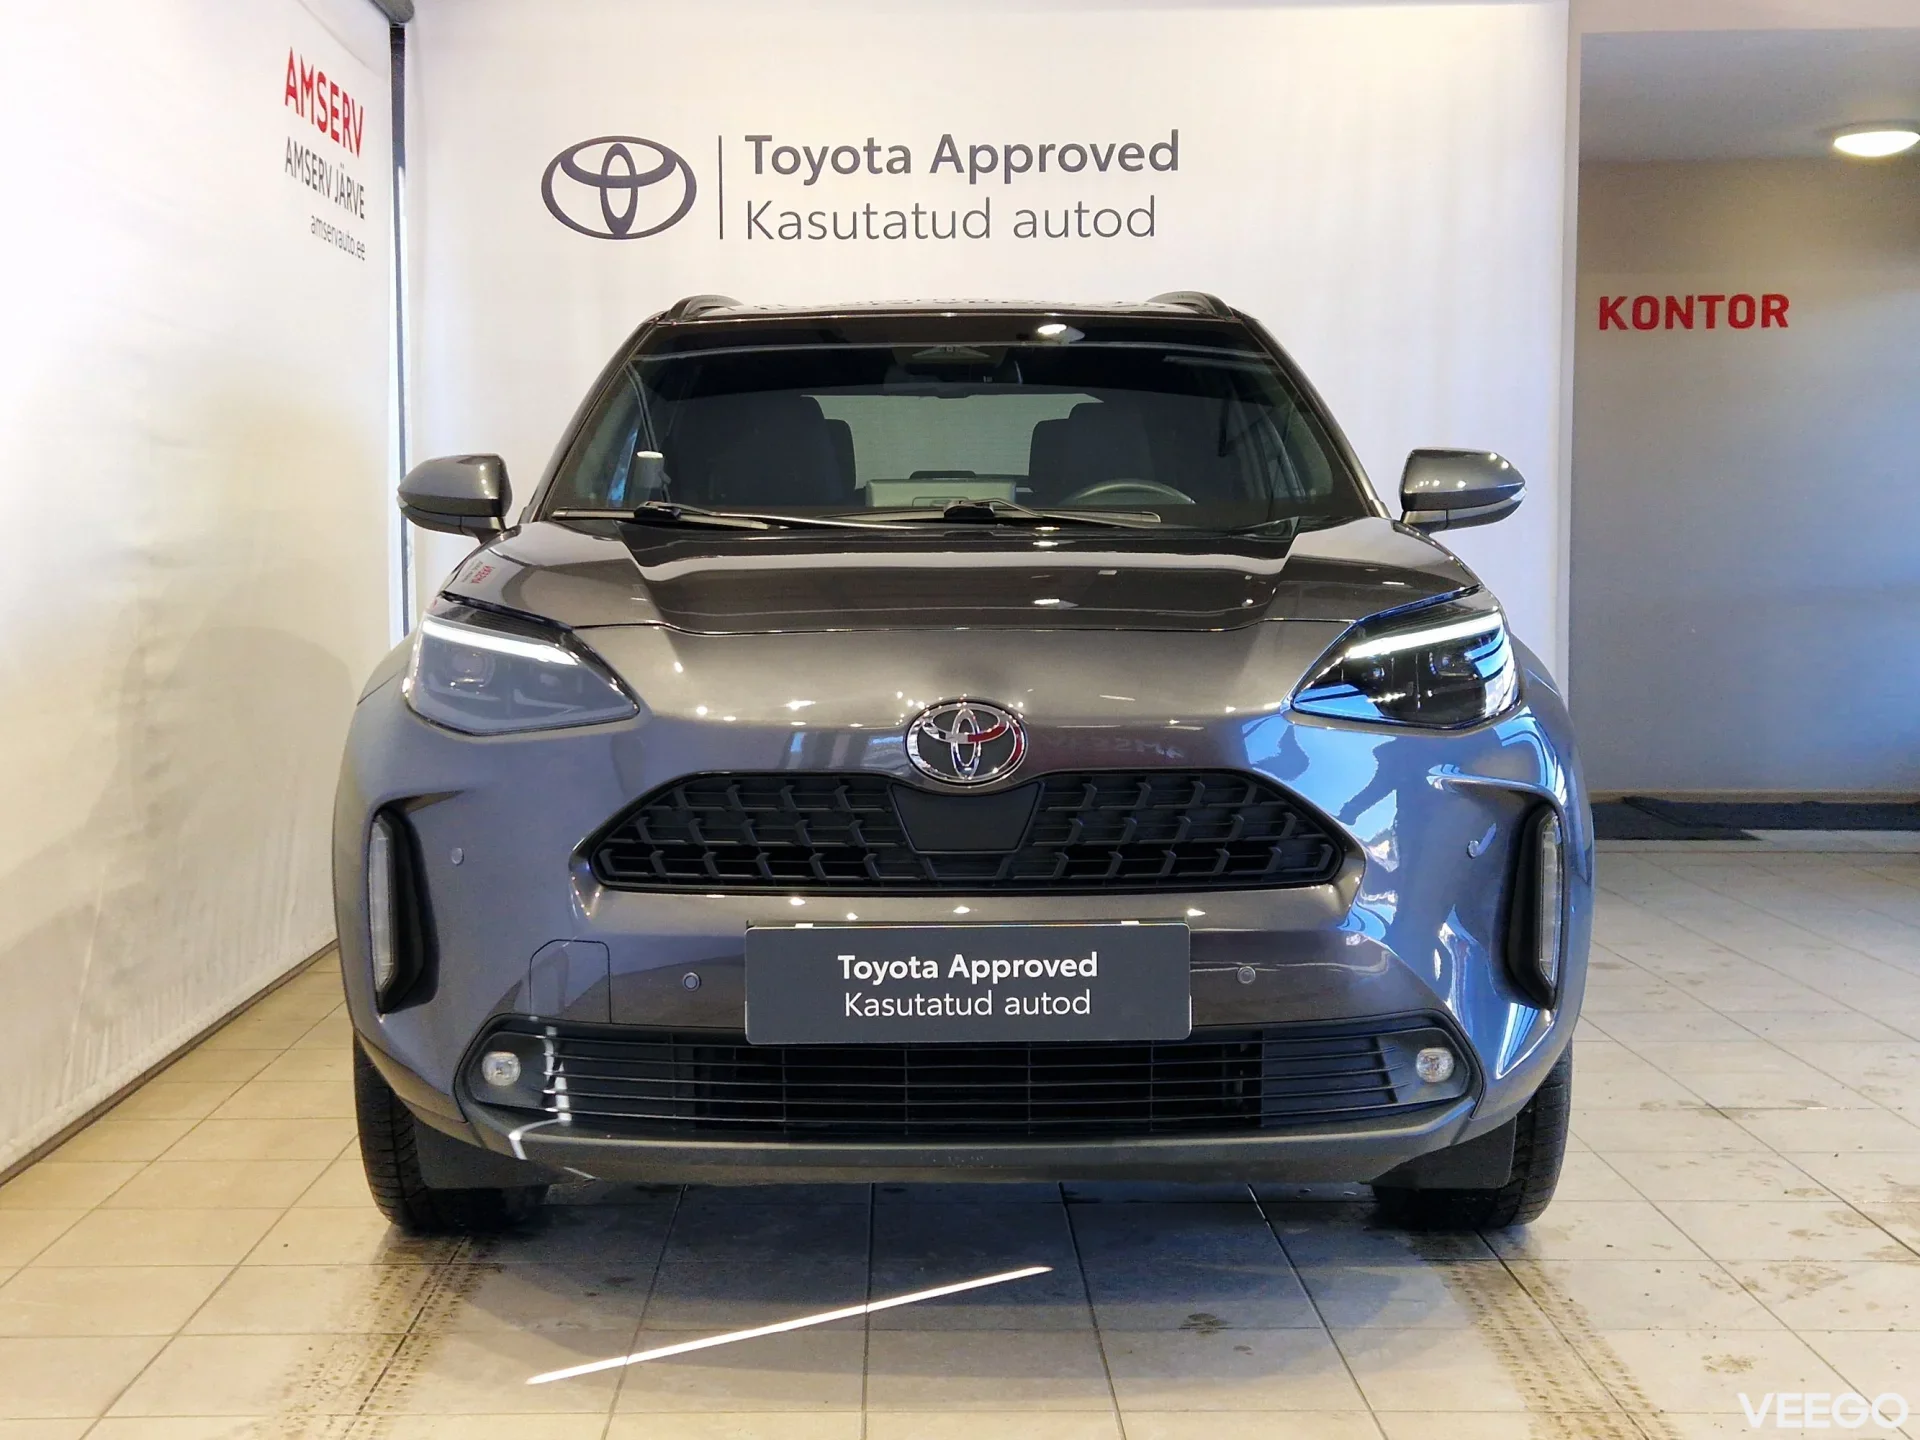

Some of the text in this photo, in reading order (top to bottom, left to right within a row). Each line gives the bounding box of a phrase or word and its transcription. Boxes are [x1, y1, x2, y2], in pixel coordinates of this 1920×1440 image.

[285, 46, 364, 158] AMSERV
[285, 136, 365, 220] AMSERV JÄRVE
[745, 129, 1178, 185] Toyota Approved
[310, 215, 365, 261] amservauto.ee
[748, 195, 1154, 240] Kasutatud autod
[1599, 293, 1790, 331] KONTOR
[838, 952, 1097, 985] Toyota Approved
[846, 989, 1090, 1016] Kasutatud autod
